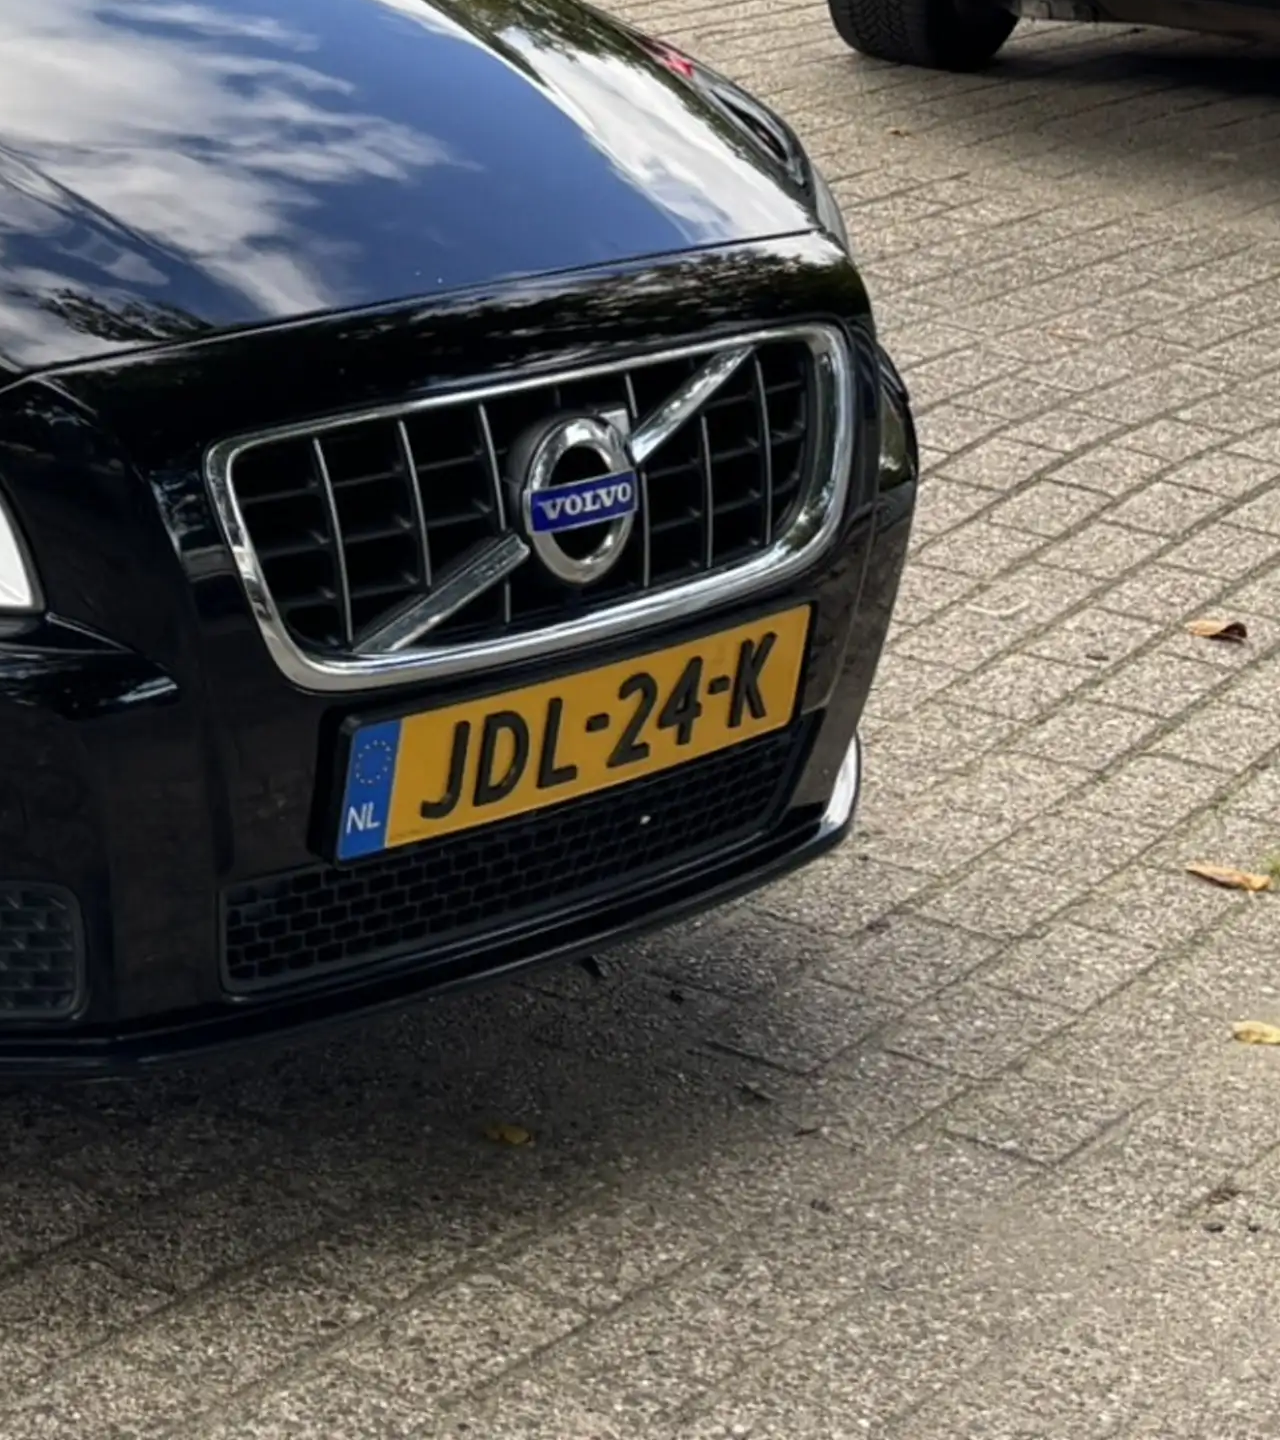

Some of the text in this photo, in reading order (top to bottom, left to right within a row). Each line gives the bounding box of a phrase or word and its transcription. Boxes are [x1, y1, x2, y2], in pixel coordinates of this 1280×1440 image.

[540, 482, 633, 520] VOLVO
[419, 630, 778, 820] JDL-24-K
[345, 803, 381, 833] NL
